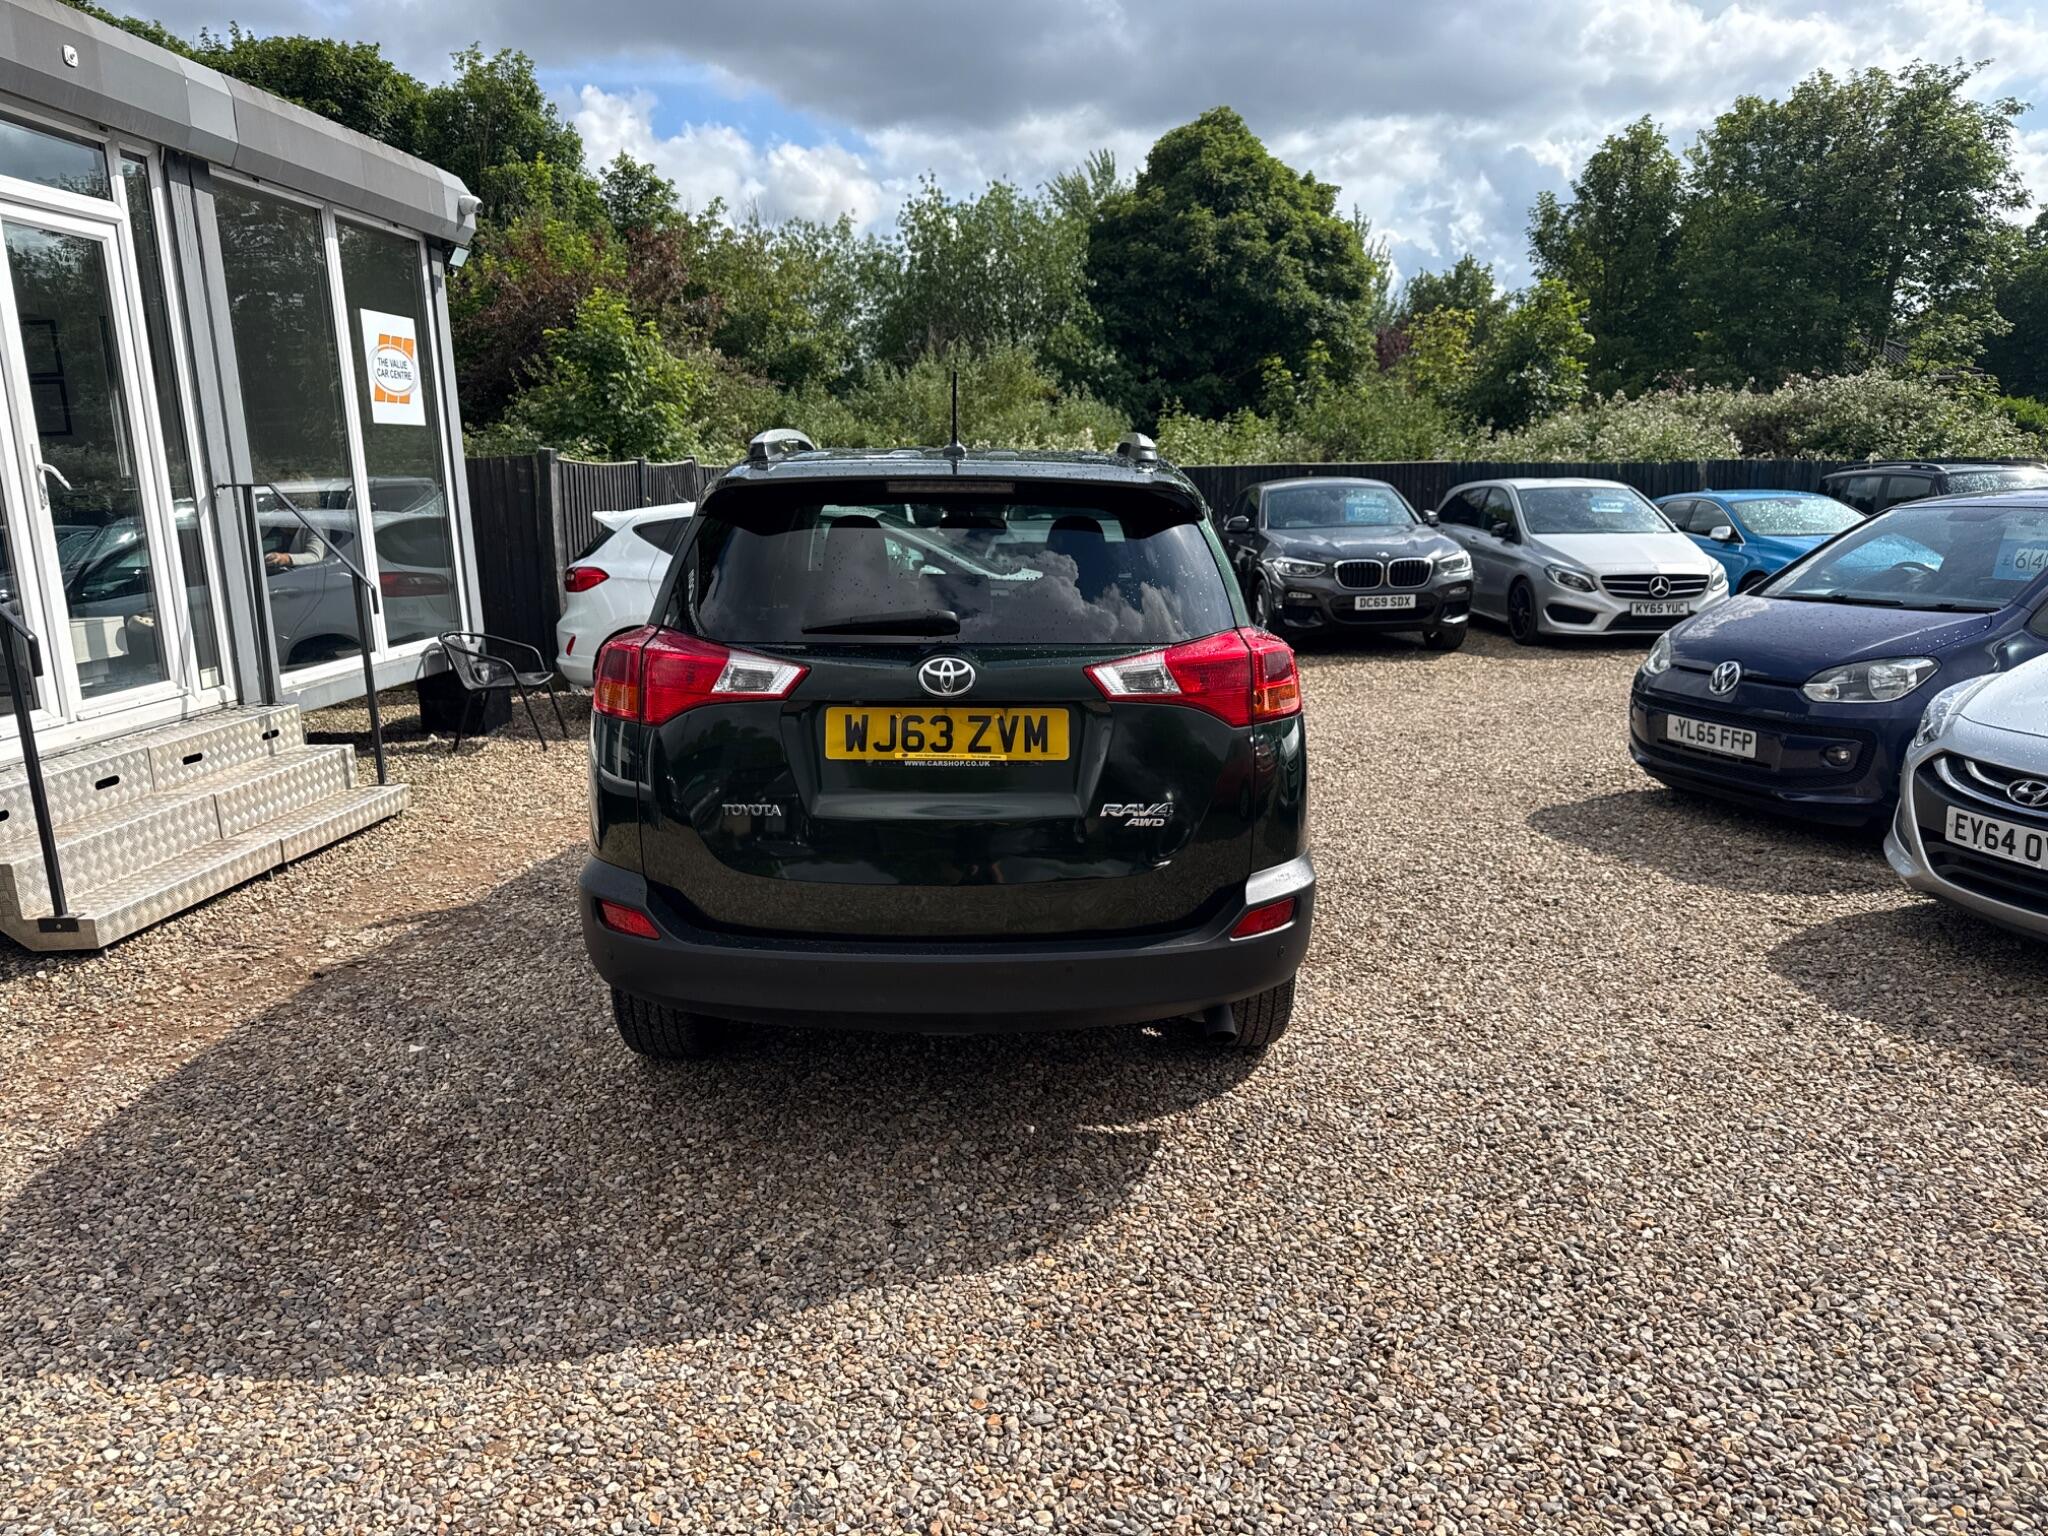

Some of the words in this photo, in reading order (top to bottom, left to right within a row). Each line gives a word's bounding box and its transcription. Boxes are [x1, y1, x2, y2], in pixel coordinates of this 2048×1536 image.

[377, 357, 389, 368] THE
[389, 359, 408, 370] VALUE
[377, 368, 390, 379] CAR
[390, 370, 412, 381] CENTRE
[1360, 597, 1388, 608] DC69
[1390, 596, 1410, 607] SDX
[1635, 603, 1663, 614] KY65
[1666, 602, 1684, 613] YUC
[845, 714, 954, 753] WJ63
[967, 715, 1048, 753] ZVM
[1678, 719, 1716, 745] YL65
[1720, 727, 1753, 752] FFP
[721, 803, 782, 817] TOYOTA
[1100, 801, 1174, 817] RAV4
[1124, 818, 1165, 827] AWD
[1954, 813, 2016, 855] EY64
